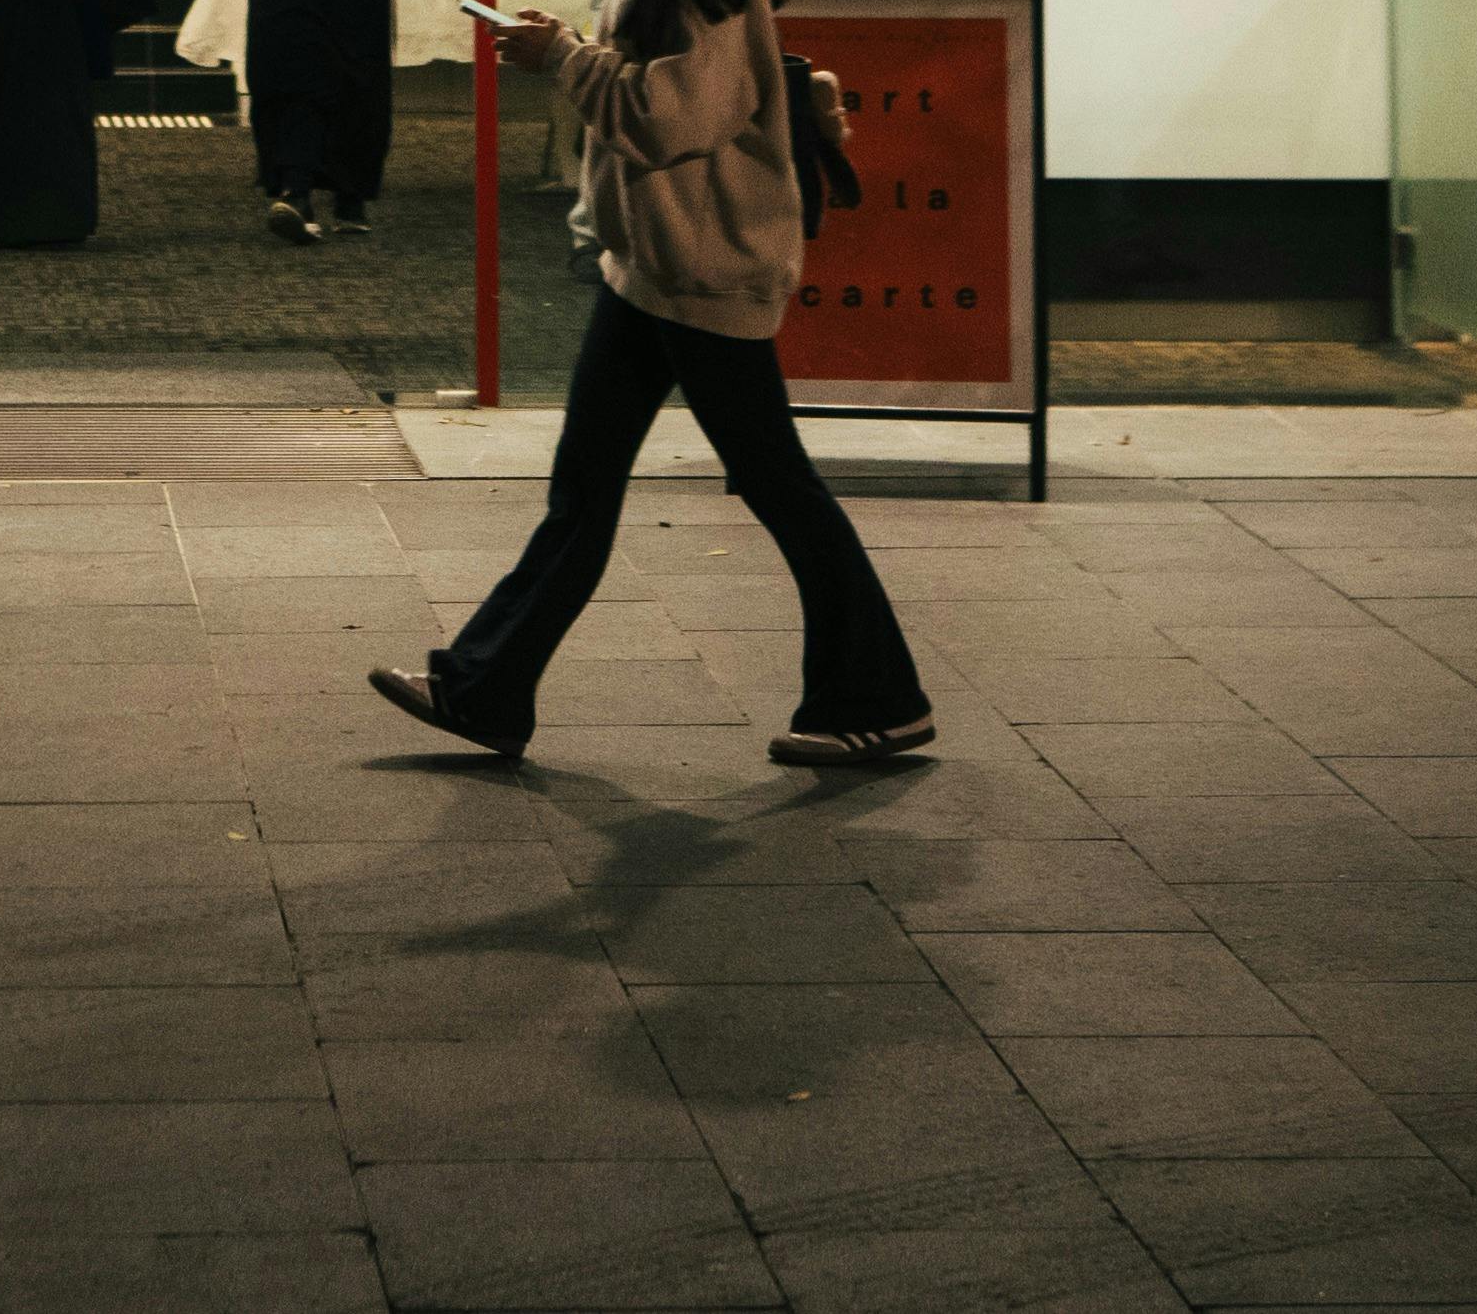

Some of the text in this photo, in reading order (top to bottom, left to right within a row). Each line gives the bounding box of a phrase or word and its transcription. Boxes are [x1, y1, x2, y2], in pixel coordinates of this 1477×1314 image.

[843, 88, 934, 114] art
[896, 180, 949, 211] la
[799, 284, 978, 310] carte
